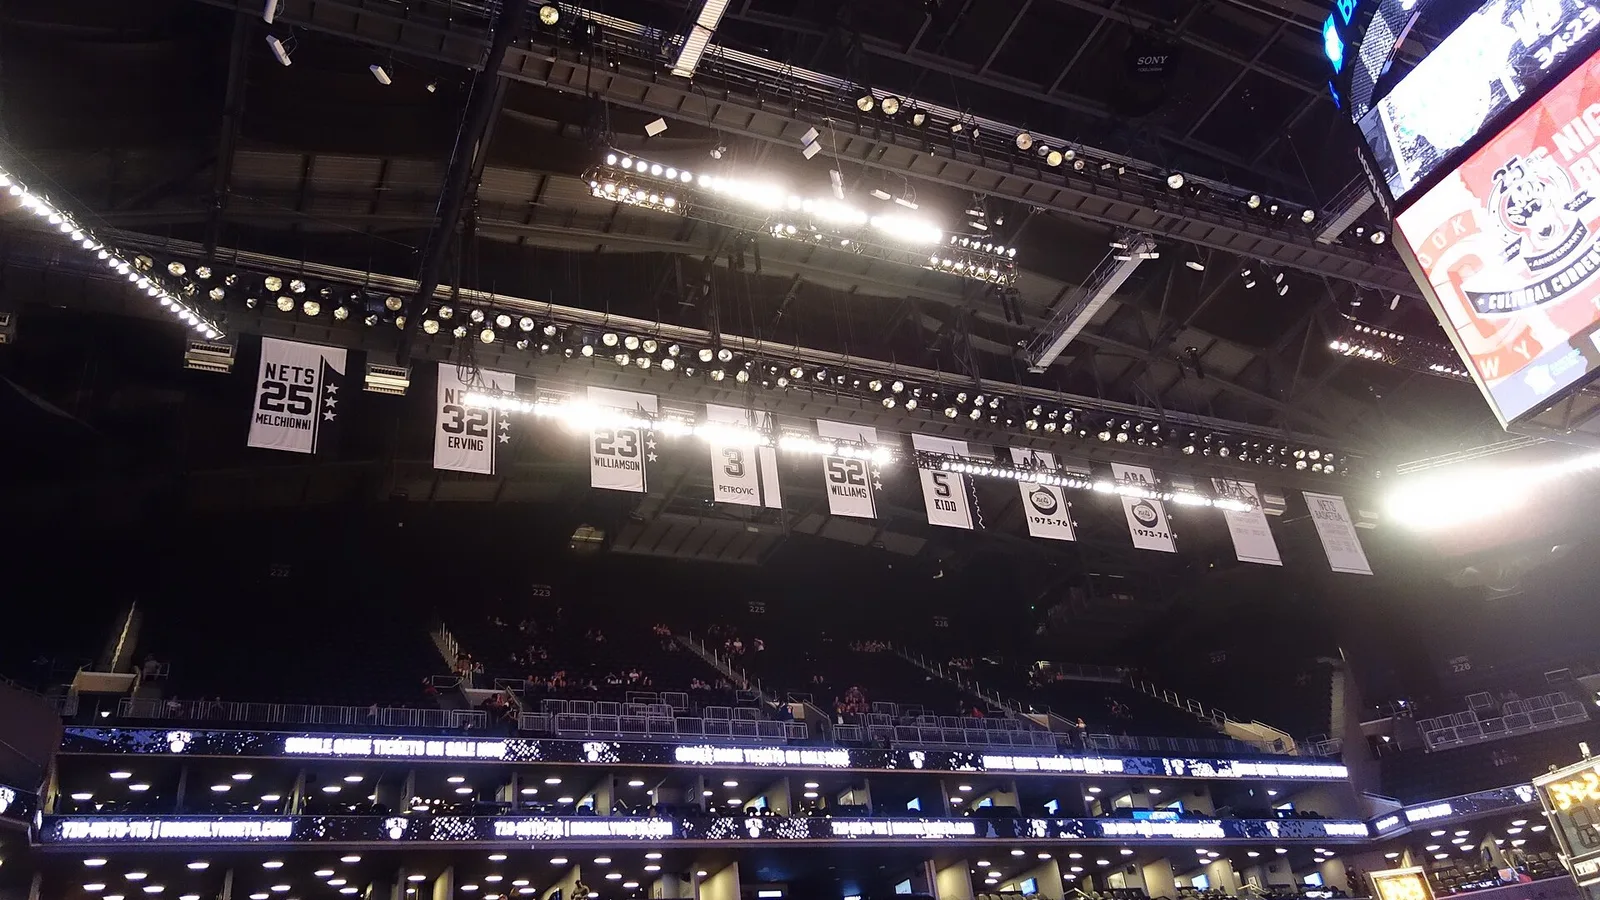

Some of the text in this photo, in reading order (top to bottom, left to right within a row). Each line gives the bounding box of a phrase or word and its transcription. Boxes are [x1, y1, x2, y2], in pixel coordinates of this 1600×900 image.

[1137, 56, 1168, 65] SONY
[1488, 282, 1551, 310] CULTURAL
[265, 362, 315, 385] NETS
[259, 380, 314, 416] 25
[255, 412, 312, 431] MELCHIONNI
[442, 404, 488, 438] 32
[447, 436, 484, 452] ERVING
[594, 428, 638, 458] 23
[593, 456, 641, 472] WILLIAMSON
[721, 446, 746, 479] 3
[827, 457, 866, 486] 52
[1123, 471, 1147, 483] ABA
[718, 484, 754, 497] PETROVIC
[830, 484, 867, 499] WILLIAMS
[931, 471, 952, 498] 5
[934, 498, 958, 512] KIDD
[1316, 499, 1337, 513] NETS
[1029, 515, 1069, 527] 1975-76
[1133, 527, 1170, 540] 1973-74
[533, 589, 551, 597] 223
